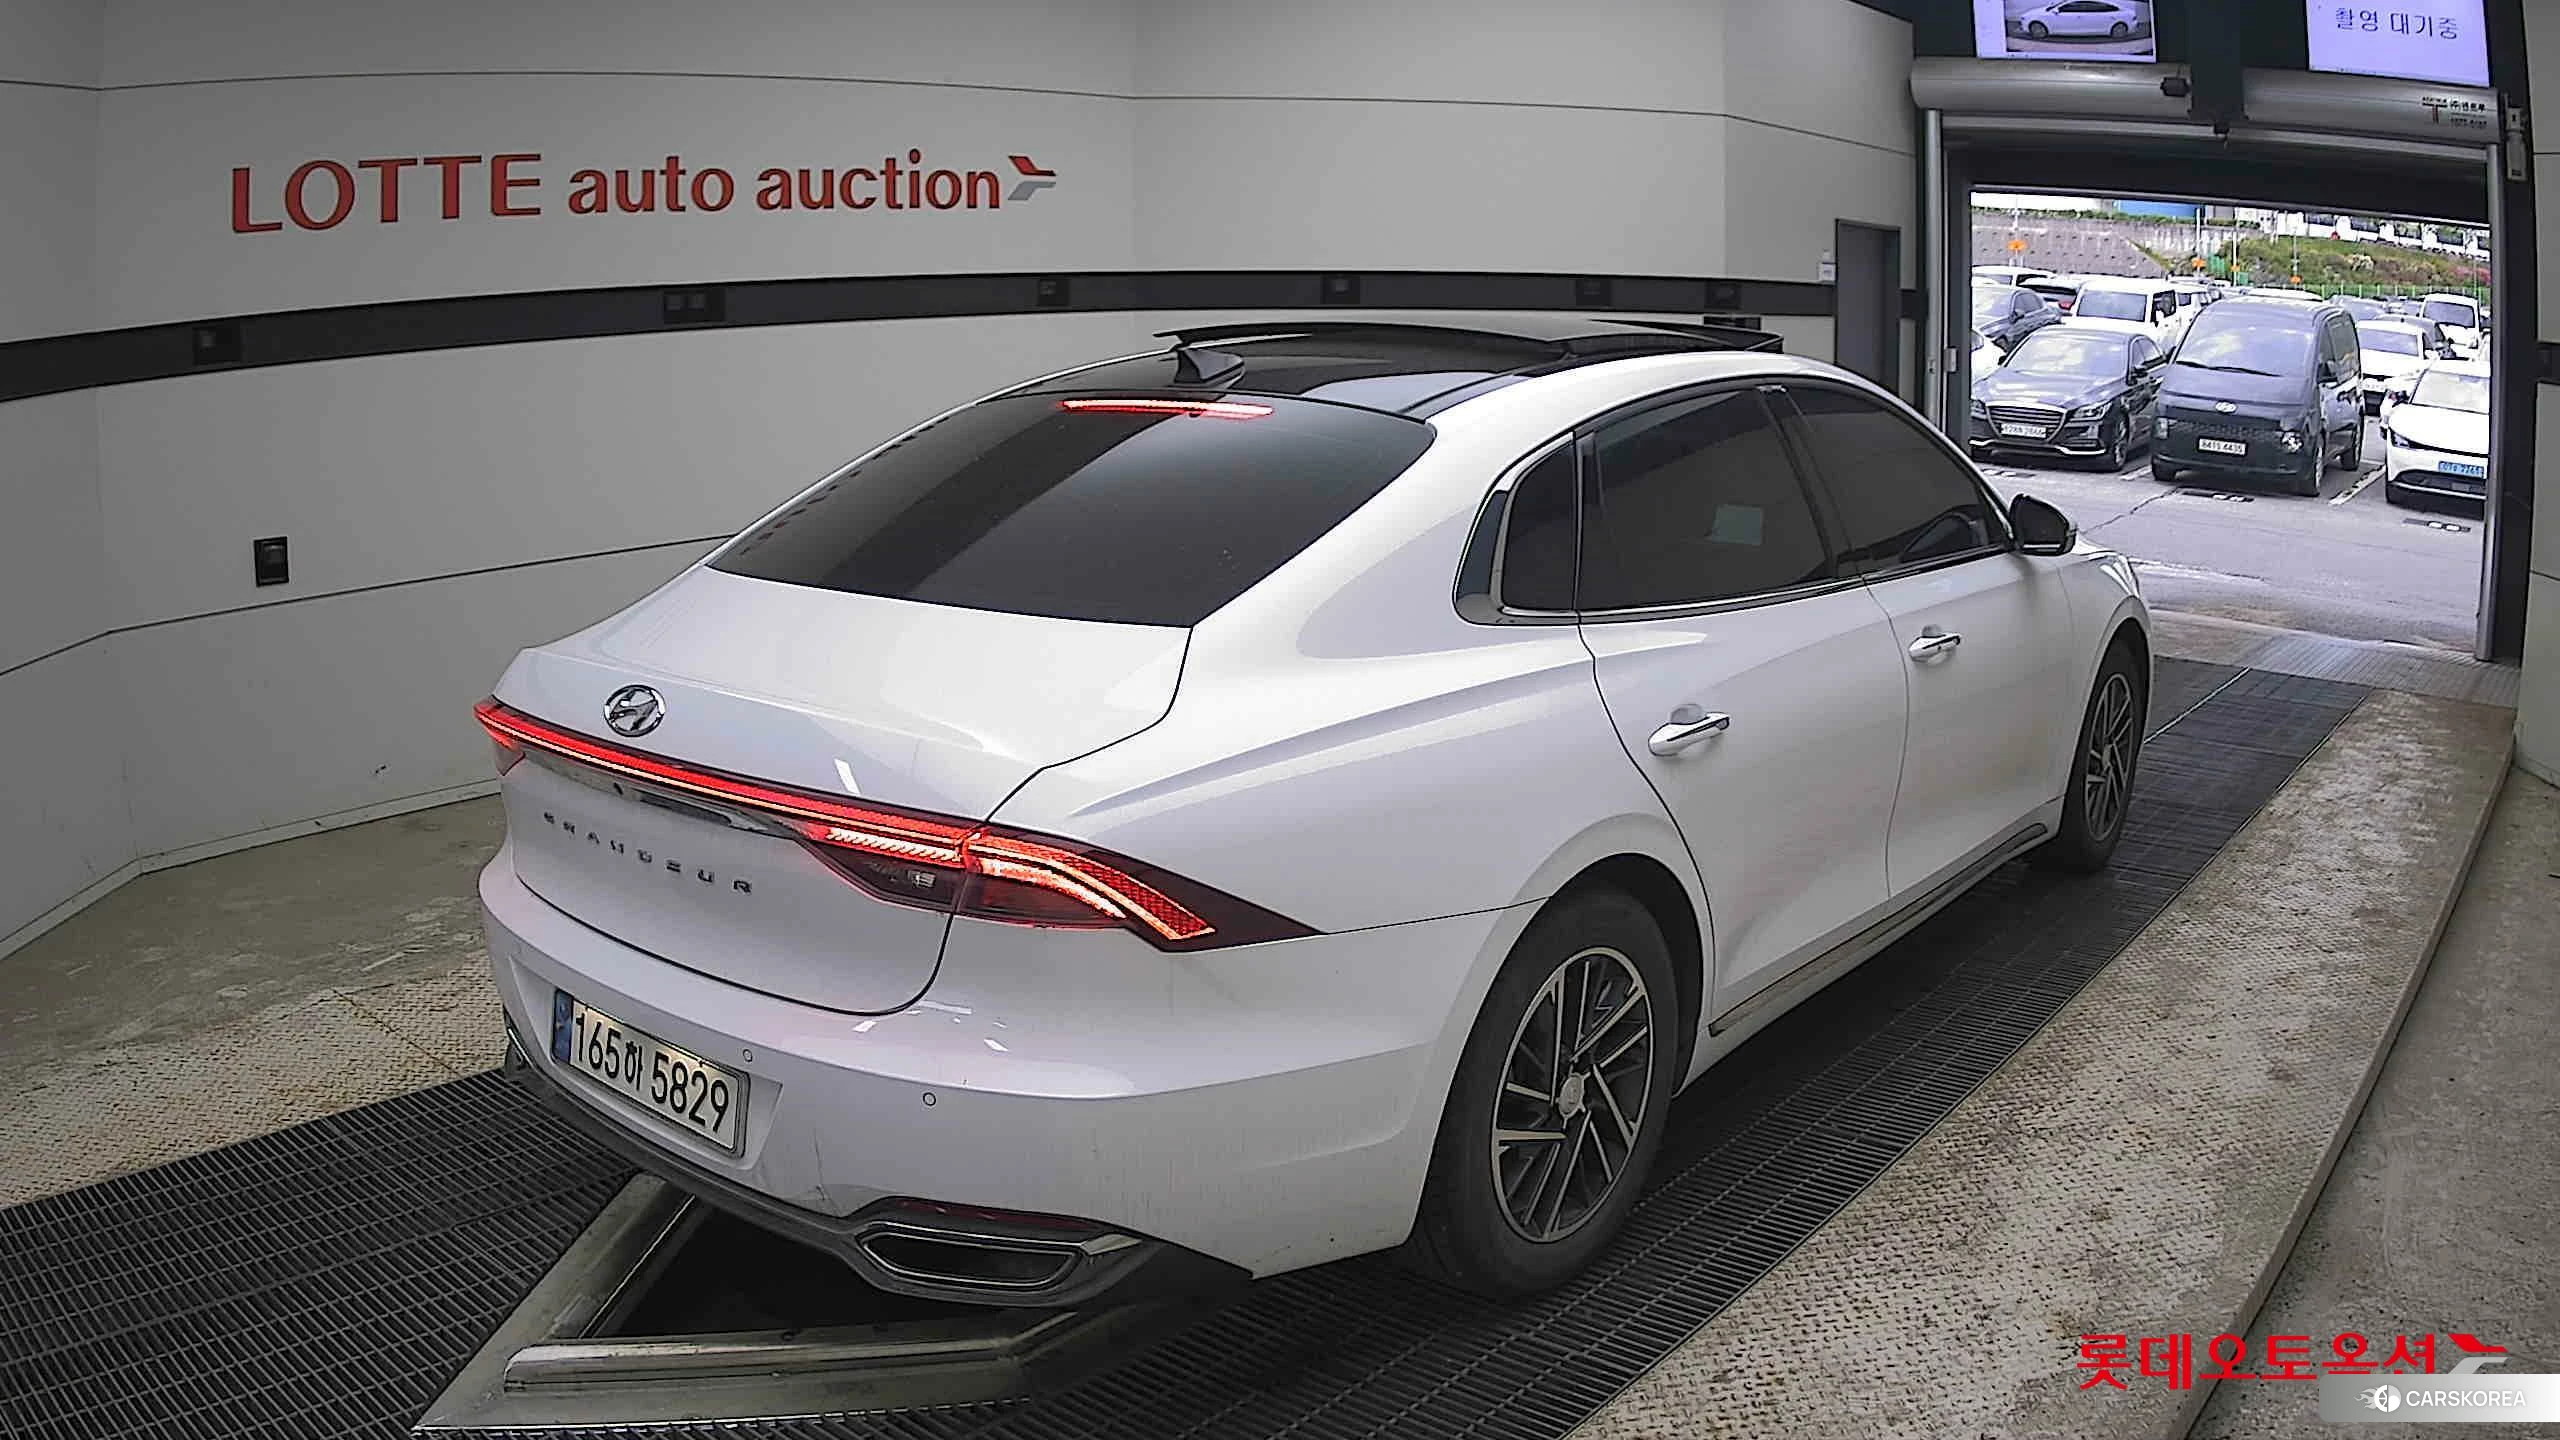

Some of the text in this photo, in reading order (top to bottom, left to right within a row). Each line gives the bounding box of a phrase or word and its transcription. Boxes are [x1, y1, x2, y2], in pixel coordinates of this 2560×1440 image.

[2335, 7, 2458, 40] 촬영 대기중
[231, 148, 1001, 234] LOTTE auto auction
[575, 1012, 730, 1134] 165하 5829
